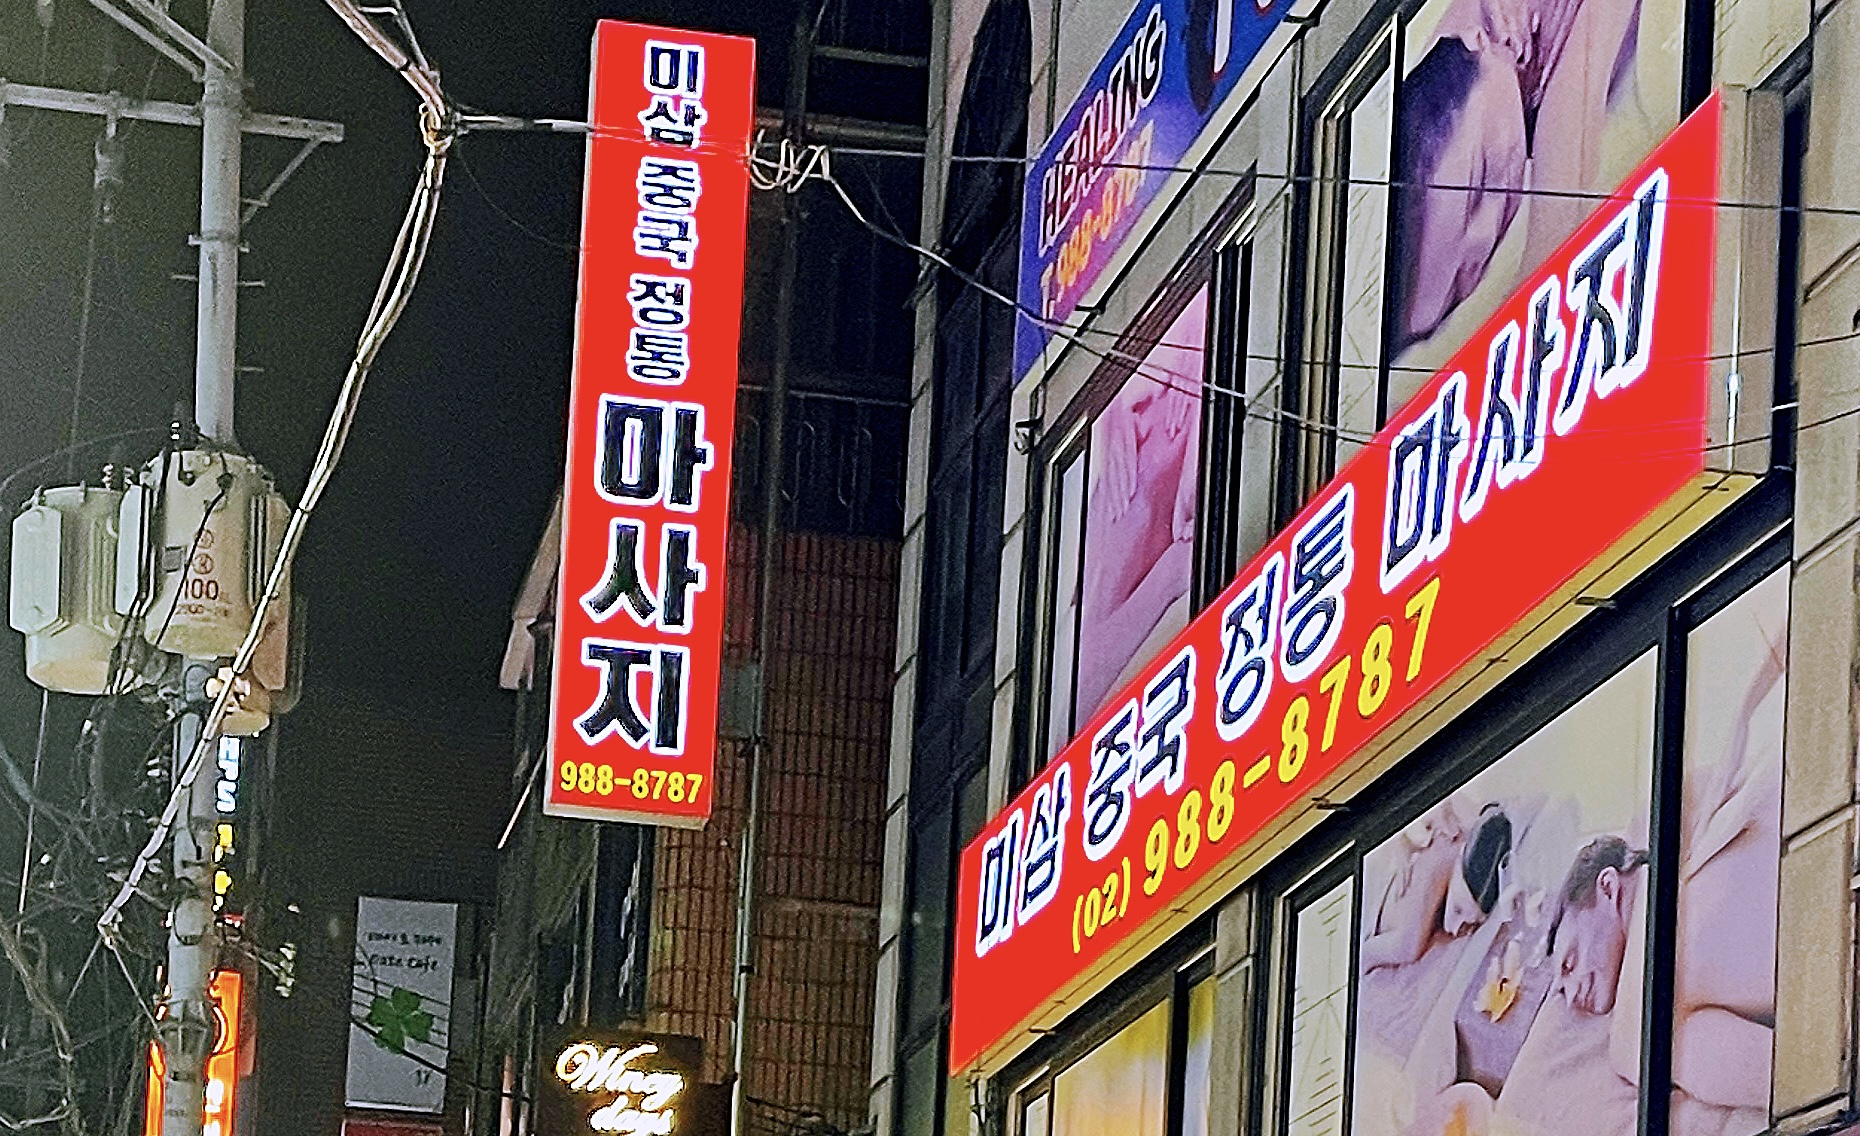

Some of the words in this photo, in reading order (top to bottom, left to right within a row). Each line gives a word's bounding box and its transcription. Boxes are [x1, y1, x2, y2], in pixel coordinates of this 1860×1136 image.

[638, 39, 707, 151] 미삼
[1039, 3, 1166, 257] HEALING
[634, 156, 700, 269] 중국
[626, 273, 690, 385] 정통
[573, 393, 714, 755] 마사지
[975, 762, 1072, 957] 미삼
[1083, 644, 1197, 861] 중국
[1215, 483, 1354, 741] 정통
[1379, 167, 1668, 593] 마사지
[560, 759, 703, 803] 988-8787
[1072, 857, 1131, 955] (02)
[1143, 577, 1441, 898] 988-8787
